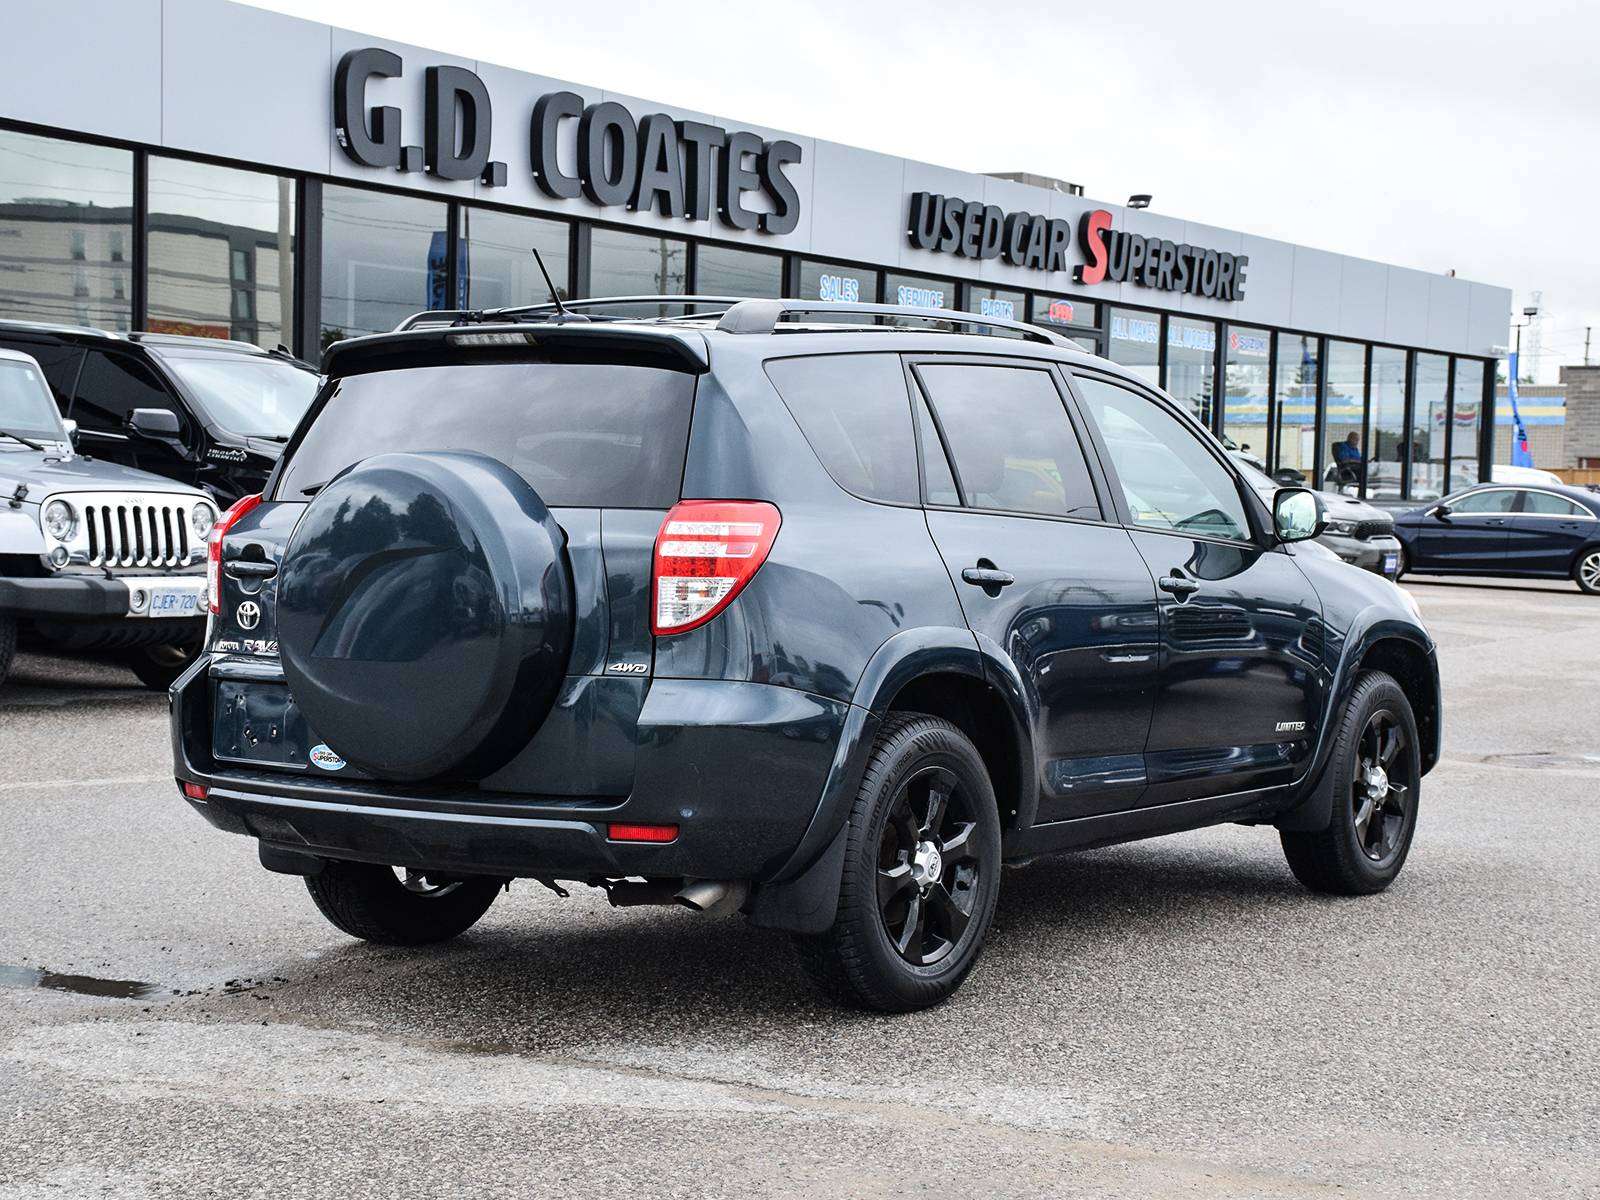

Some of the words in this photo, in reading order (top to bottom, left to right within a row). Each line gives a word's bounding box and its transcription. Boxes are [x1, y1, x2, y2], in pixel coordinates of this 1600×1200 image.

[334, 48, 508, 187] G.D.
[530, 91, 802, 235] COATES
[908, 191, 1004, 260] USED
[1001, 211, 1071, 272] CAR
[1073, 209, 1249, 302] SUPERSTORE
[820, 274, 859, 303] SALES
[897, 285, 944, 308] SERVICE
[981, 298, 1014, 320] PARTS
[608, 662, 648, 673] 4WD
